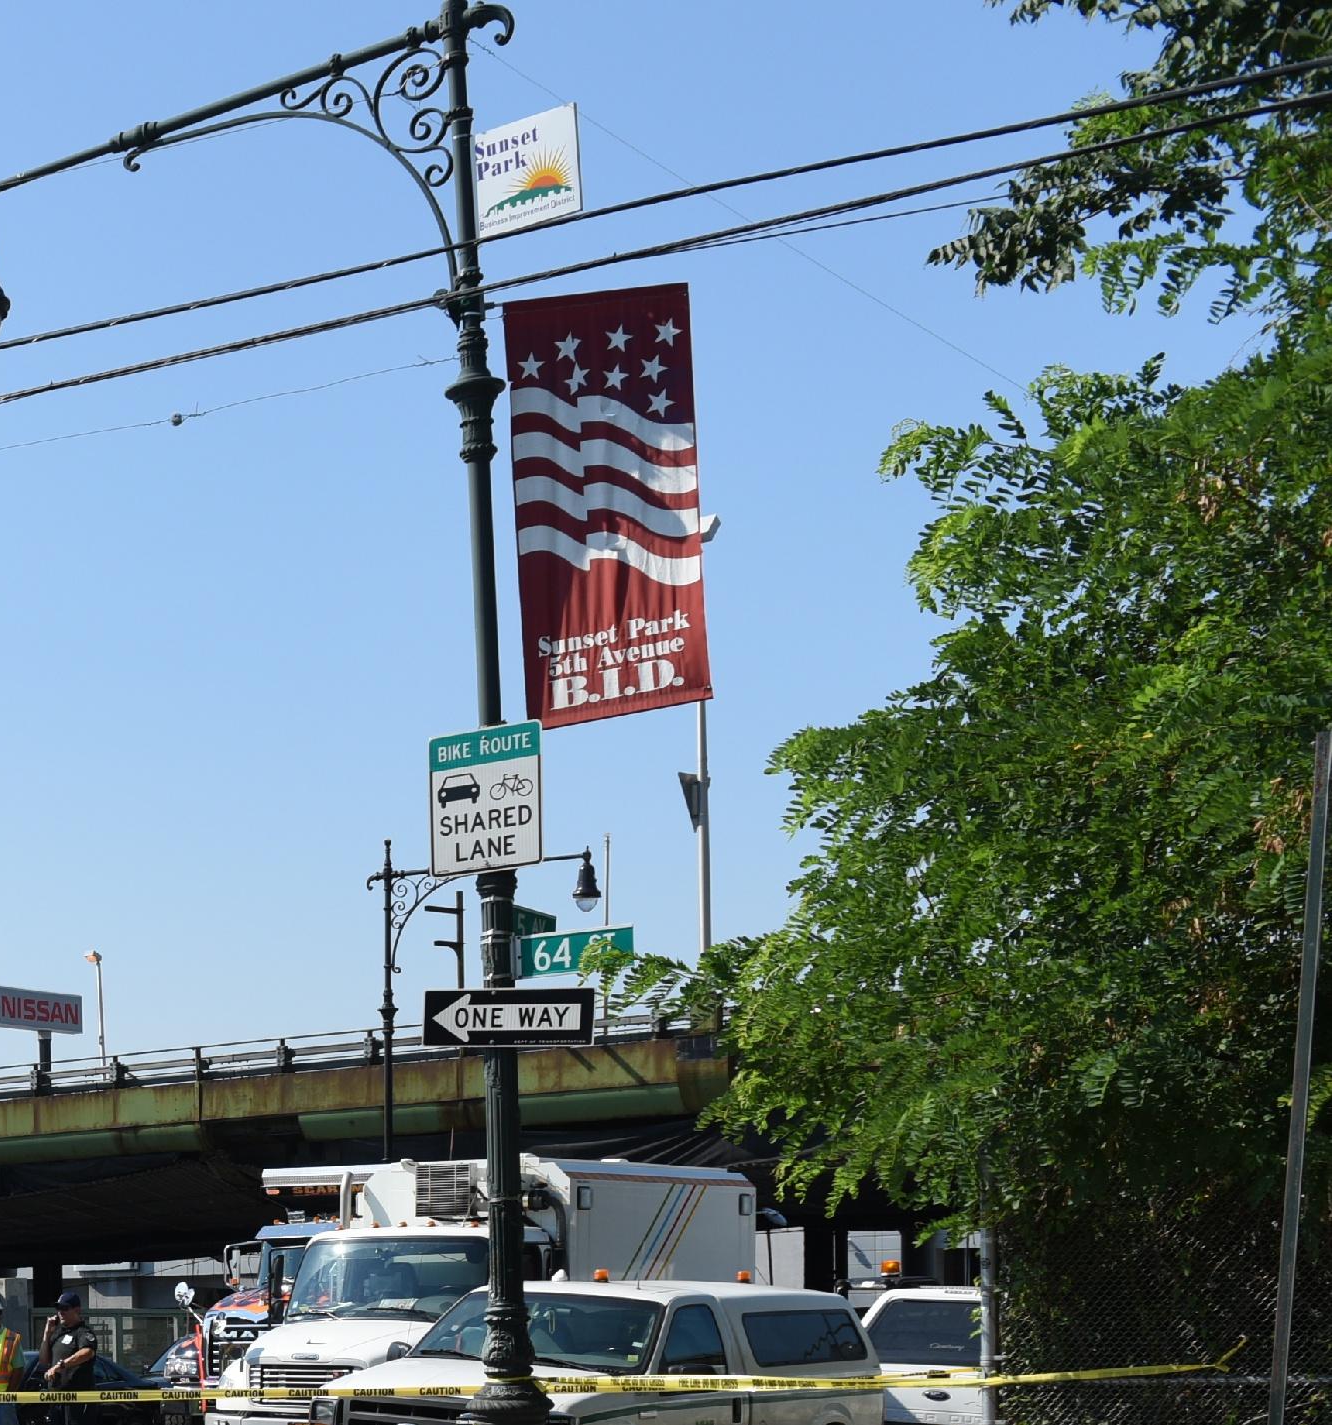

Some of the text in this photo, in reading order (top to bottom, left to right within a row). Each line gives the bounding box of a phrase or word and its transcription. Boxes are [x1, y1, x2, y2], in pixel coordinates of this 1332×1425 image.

[474, 126, 539, 160] Sunset
[477, 150, 528, 181] Park
[479, 194, 576, 231] Business Improvement District
[538, 609, 690, 658] Sunset Park
[549, 636, 685, 676] 5th Avenue
[549, 659, 685, 711] B.I.D.
[438, 732, 532, 763] BIKE ROUTE
[440, 805, 532, 836] SHARED
[455, 834, 516, 862] LANE
[517, 913, 525, 935] 5
[534, 937, 571, 971] 64
[1, 995, 79, 1025] NISSAN
[455, 1006, 570, 1028] ONE WAY
[39, 1392, 77, 1401] CAUTION
[100, 1391, 138, 1400] CAUTION
[162, 1390, 201, 1399] CAUTION
[225, 1389, 264, 1398] CAUTION
[288, 1389, 329, 1397] CAUTION
[353, 1388, 395, 1396] CAUTION
[419, 1386, 461, 1395] CAUTION
